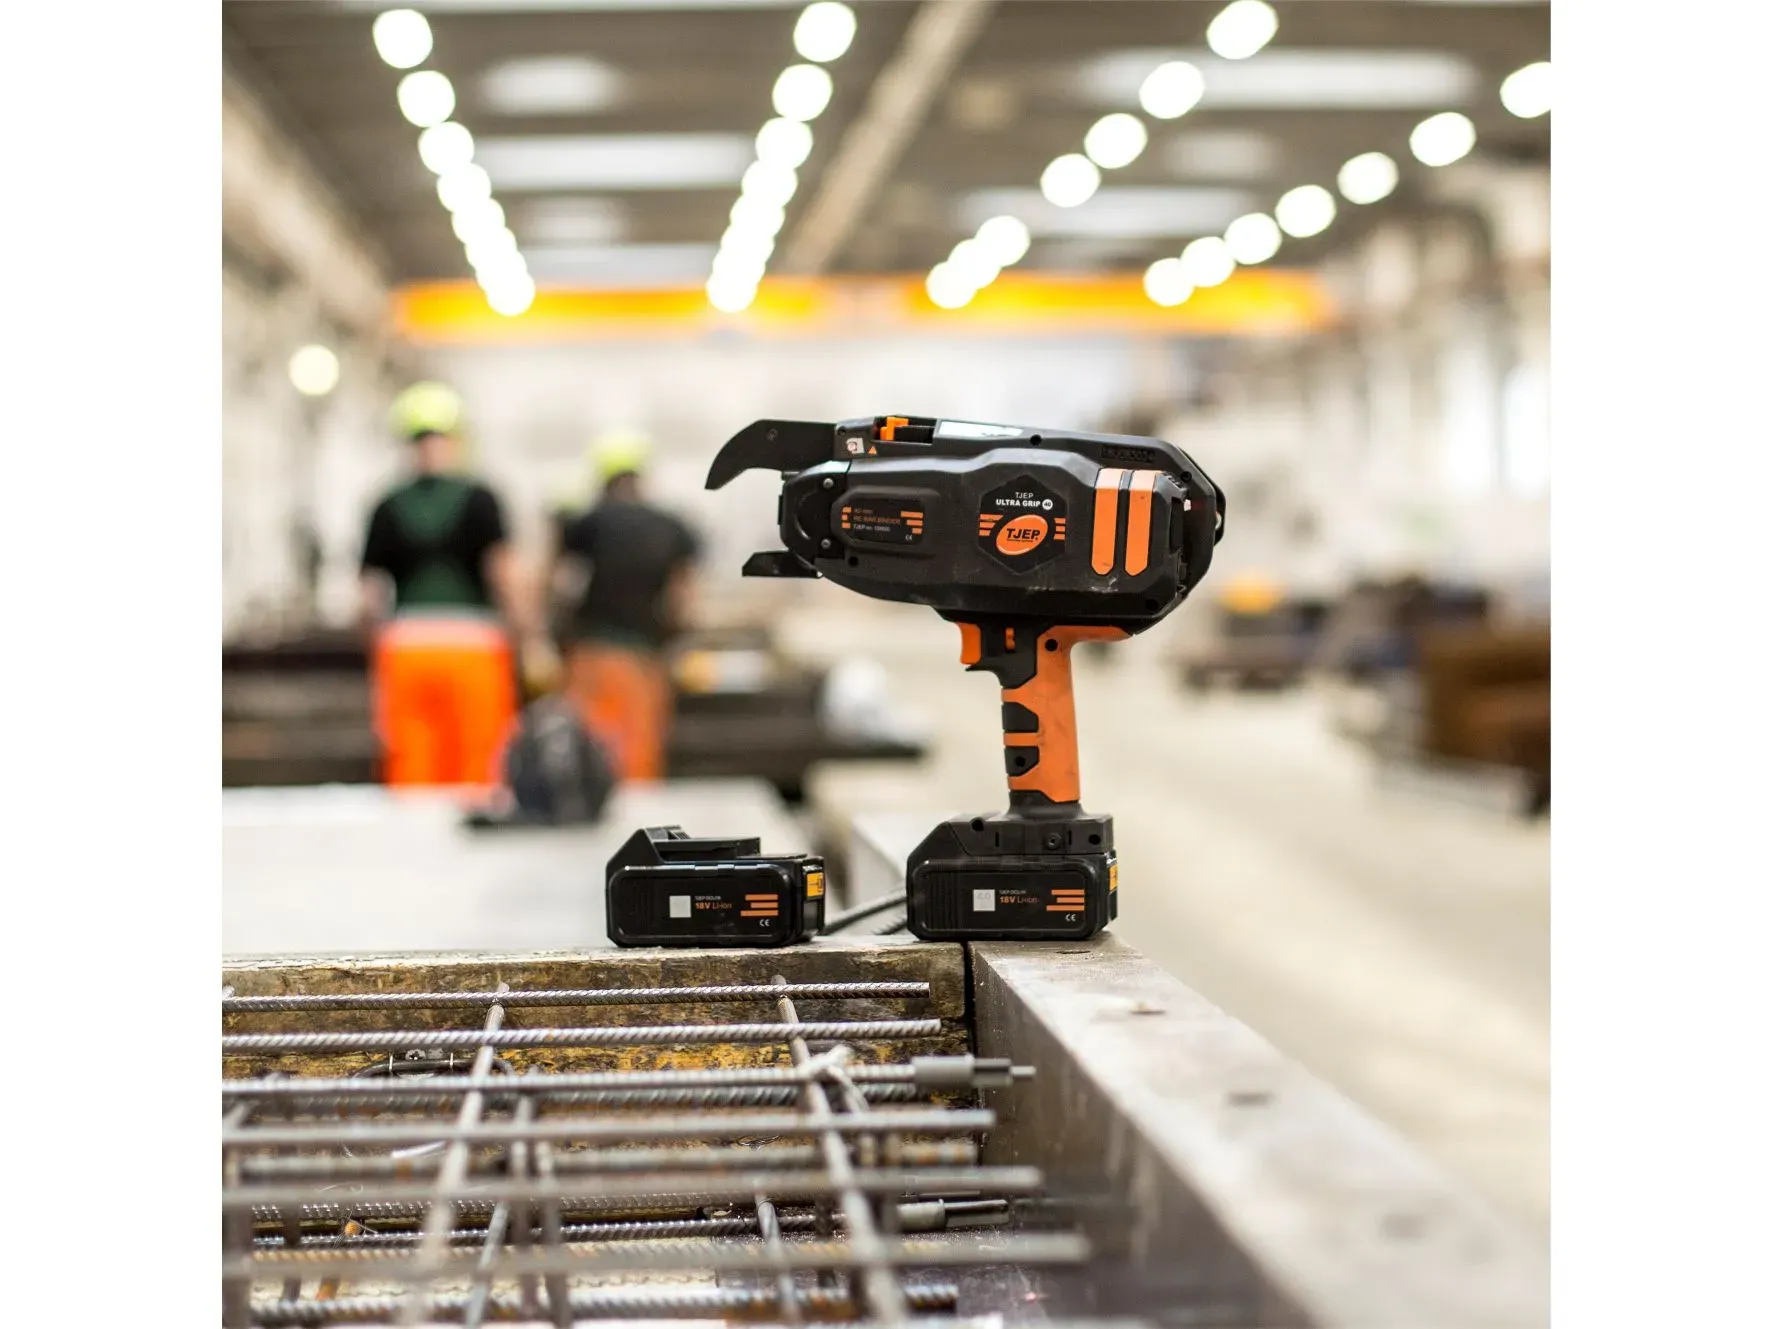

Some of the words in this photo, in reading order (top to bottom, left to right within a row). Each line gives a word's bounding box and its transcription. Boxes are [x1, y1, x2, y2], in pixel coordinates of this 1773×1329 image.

[1015, 492, 1034, 500] TJEP
[996, 499, 1021, 507] ULTRA
[1022, 500, 1041, 508] GRIP
[1006, 528, 1041, 540] TJEP
[999, 895, 1016, 904] 18V
[695, 902, 711, 910] 18V
[711, 902, 732, 910] Li-ion
